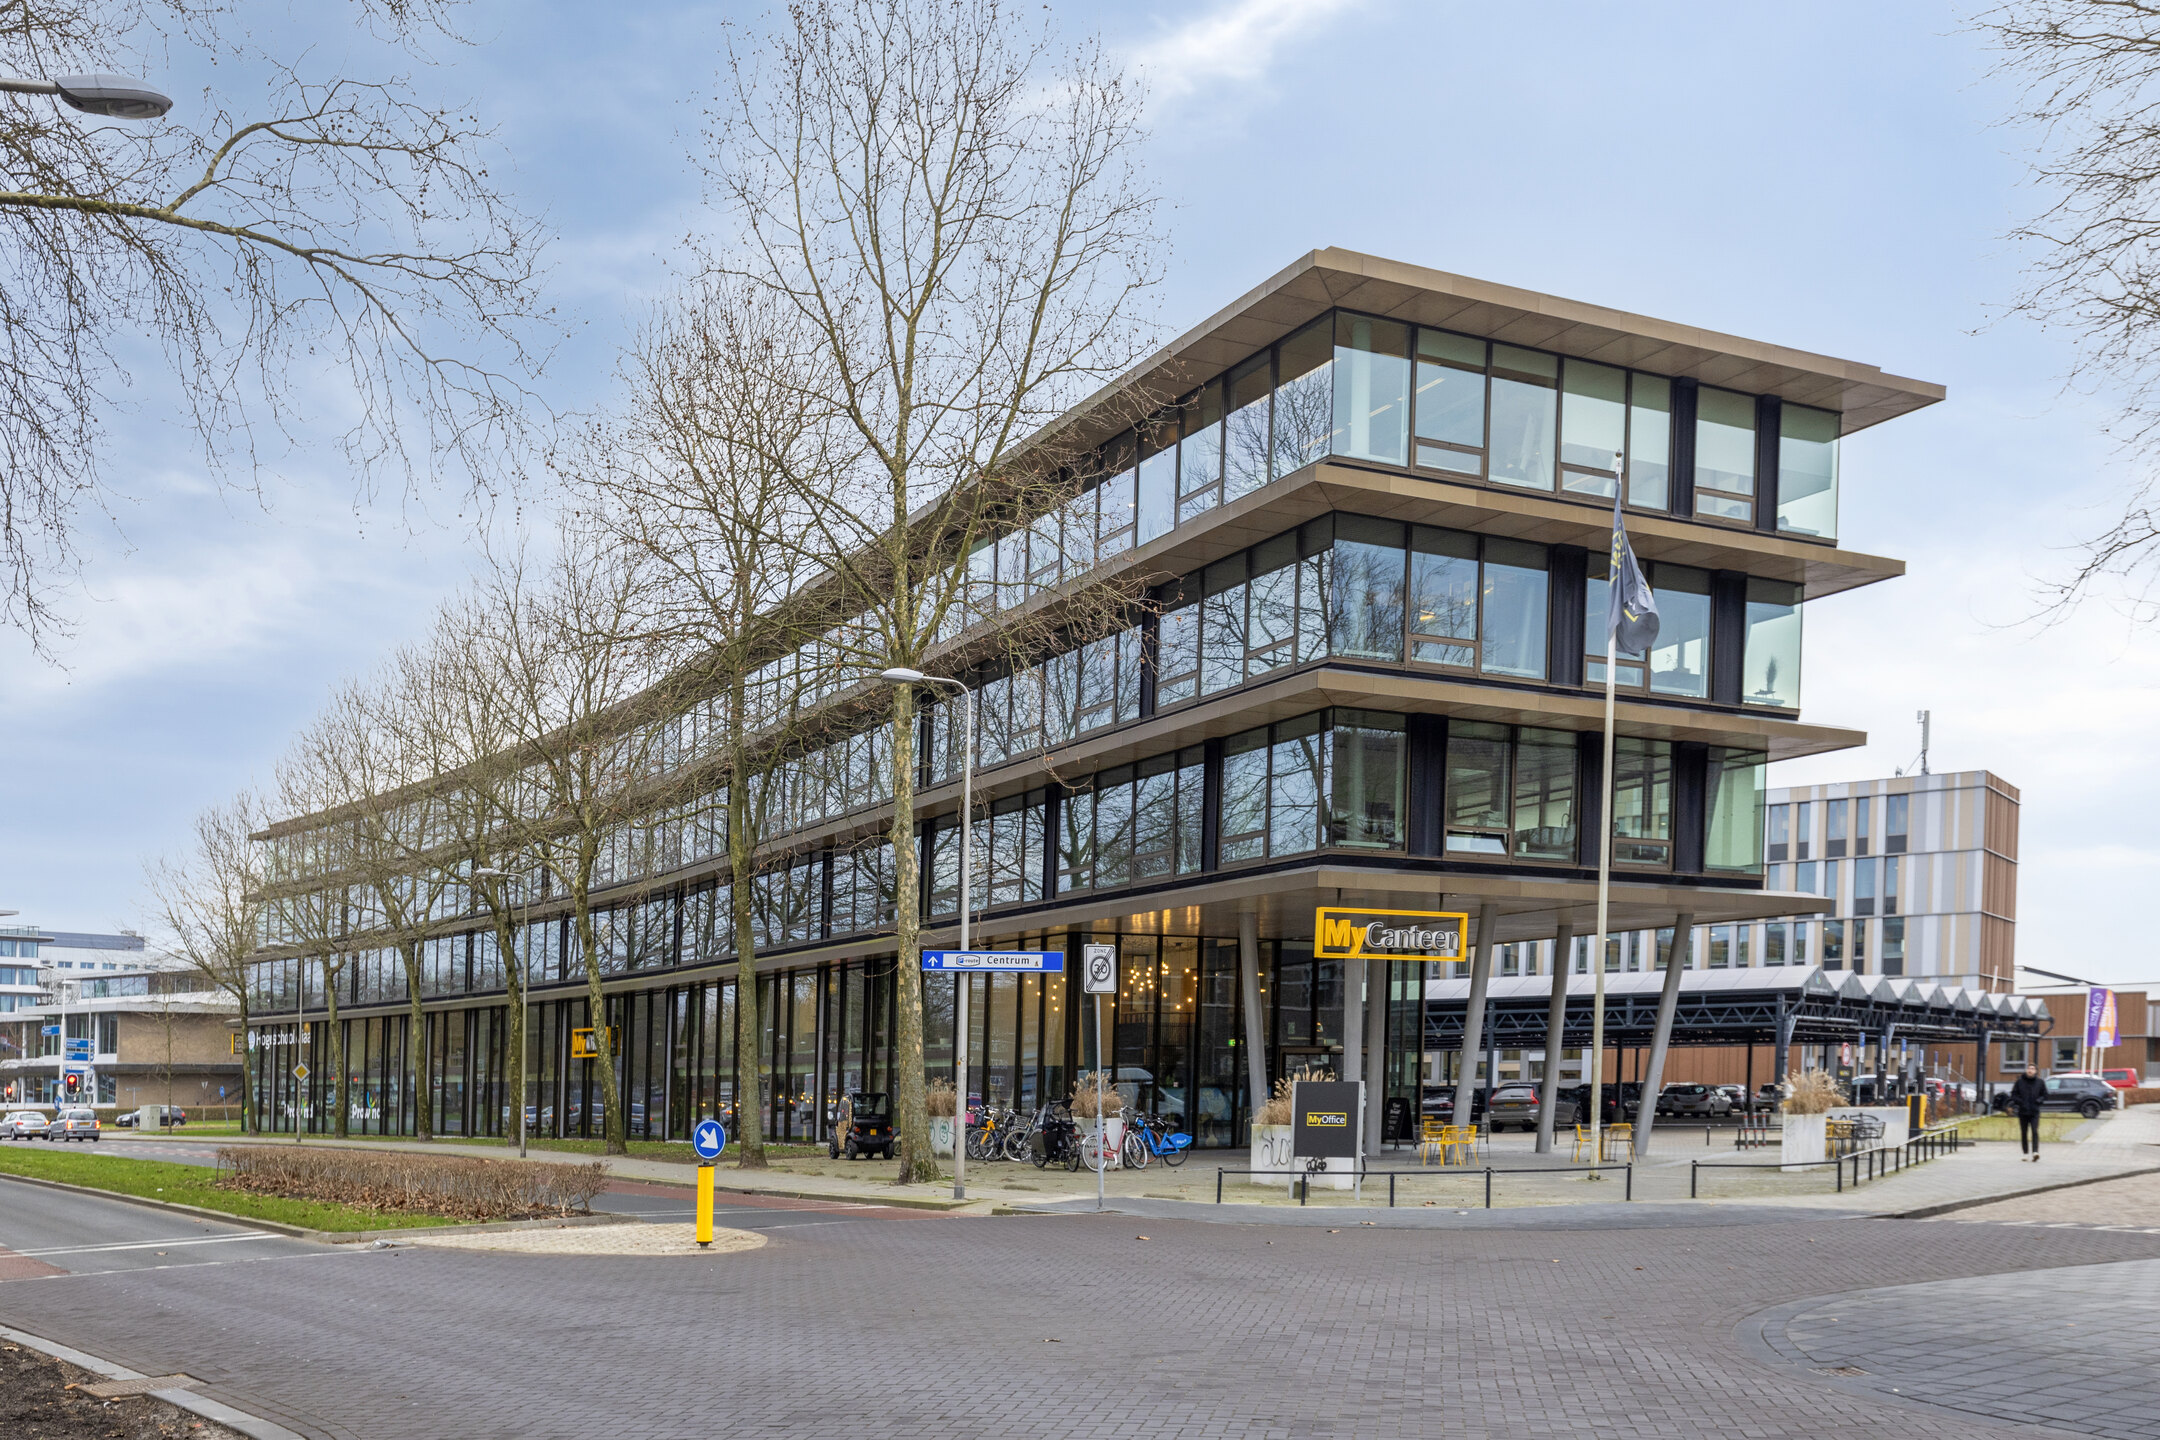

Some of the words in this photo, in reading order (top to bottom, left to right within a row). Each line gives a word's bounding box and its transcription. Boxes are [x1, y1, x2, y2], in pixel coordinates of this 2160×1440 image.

[1324, 918, 1460, 958] MyCanteen
[987, 955, 1030, 965] Centrum
[1093, 963, 1108, 974] 30
[1308, 1114, 1345, 1126] MyOffice
